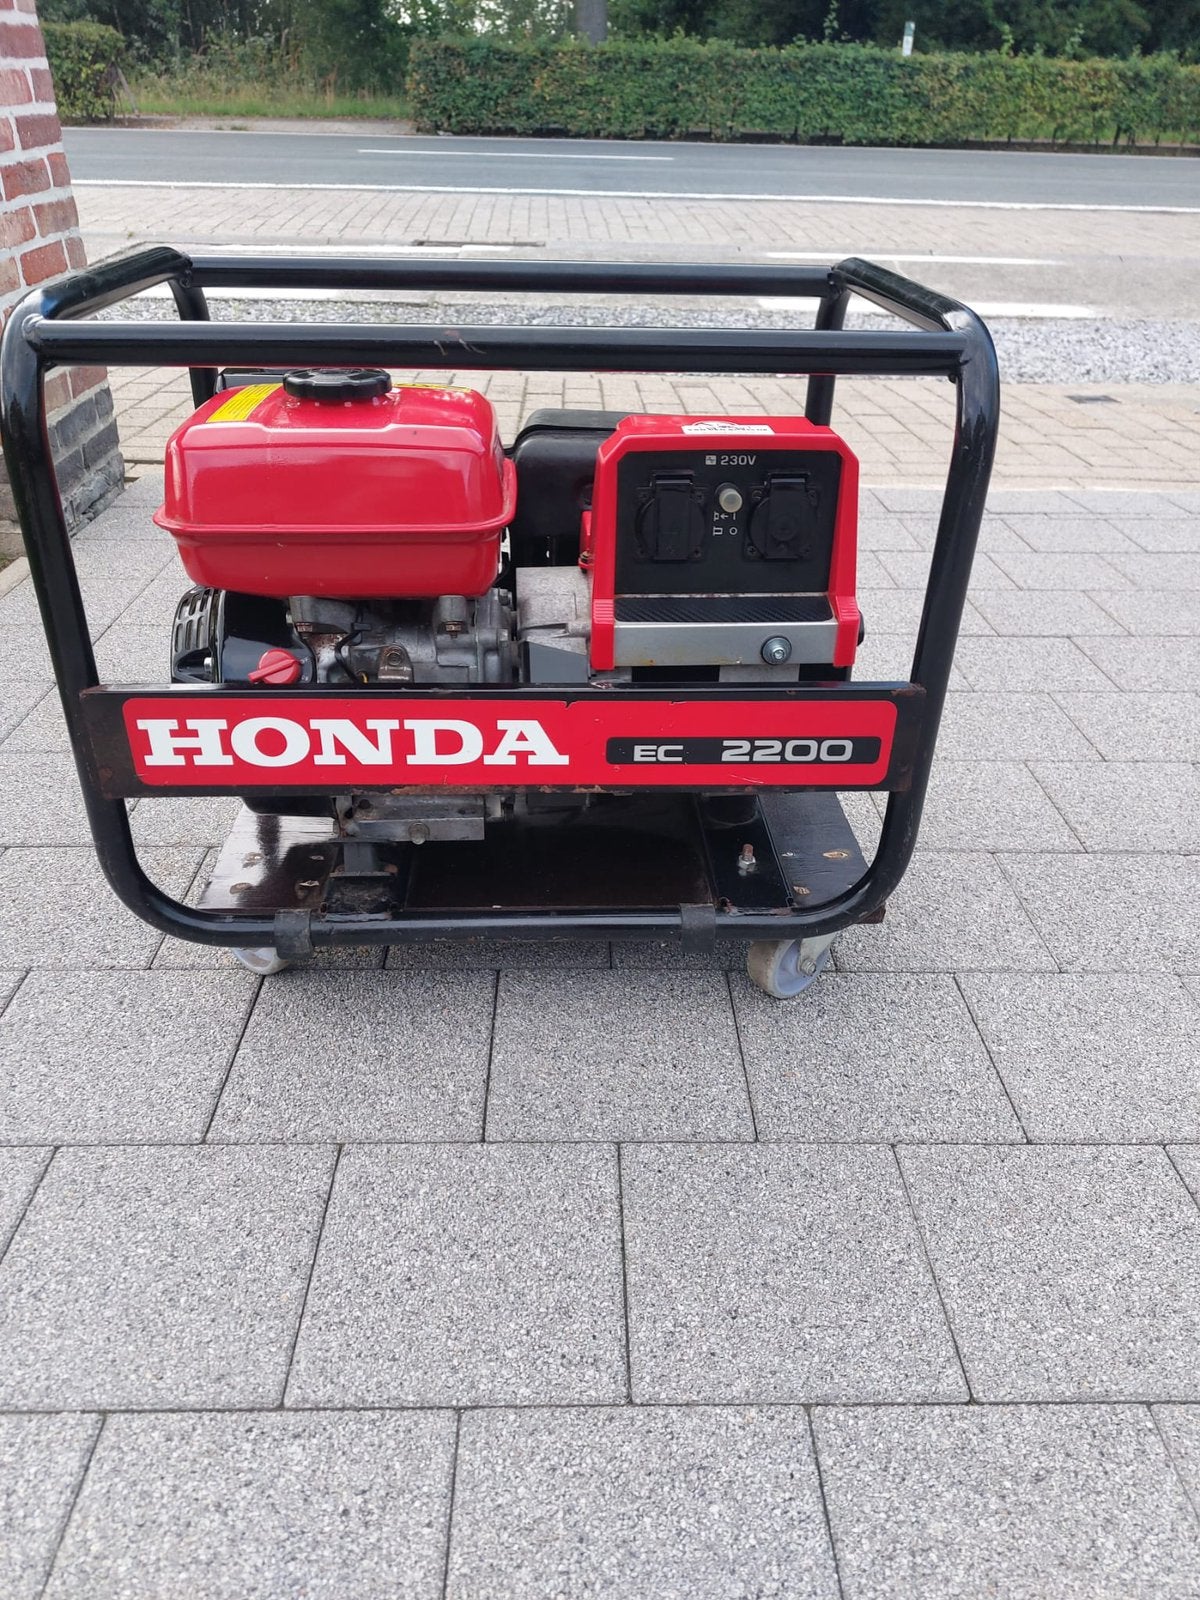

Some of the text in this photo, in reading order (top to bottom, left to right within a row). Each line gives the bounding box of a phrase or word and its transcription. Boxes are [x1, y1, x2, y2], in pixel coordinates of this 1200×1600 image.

[720, 455, 757, 466] 230V
[136, 716, 570, 768] HONDA
[633, 739, 854, 763] EC 2200
